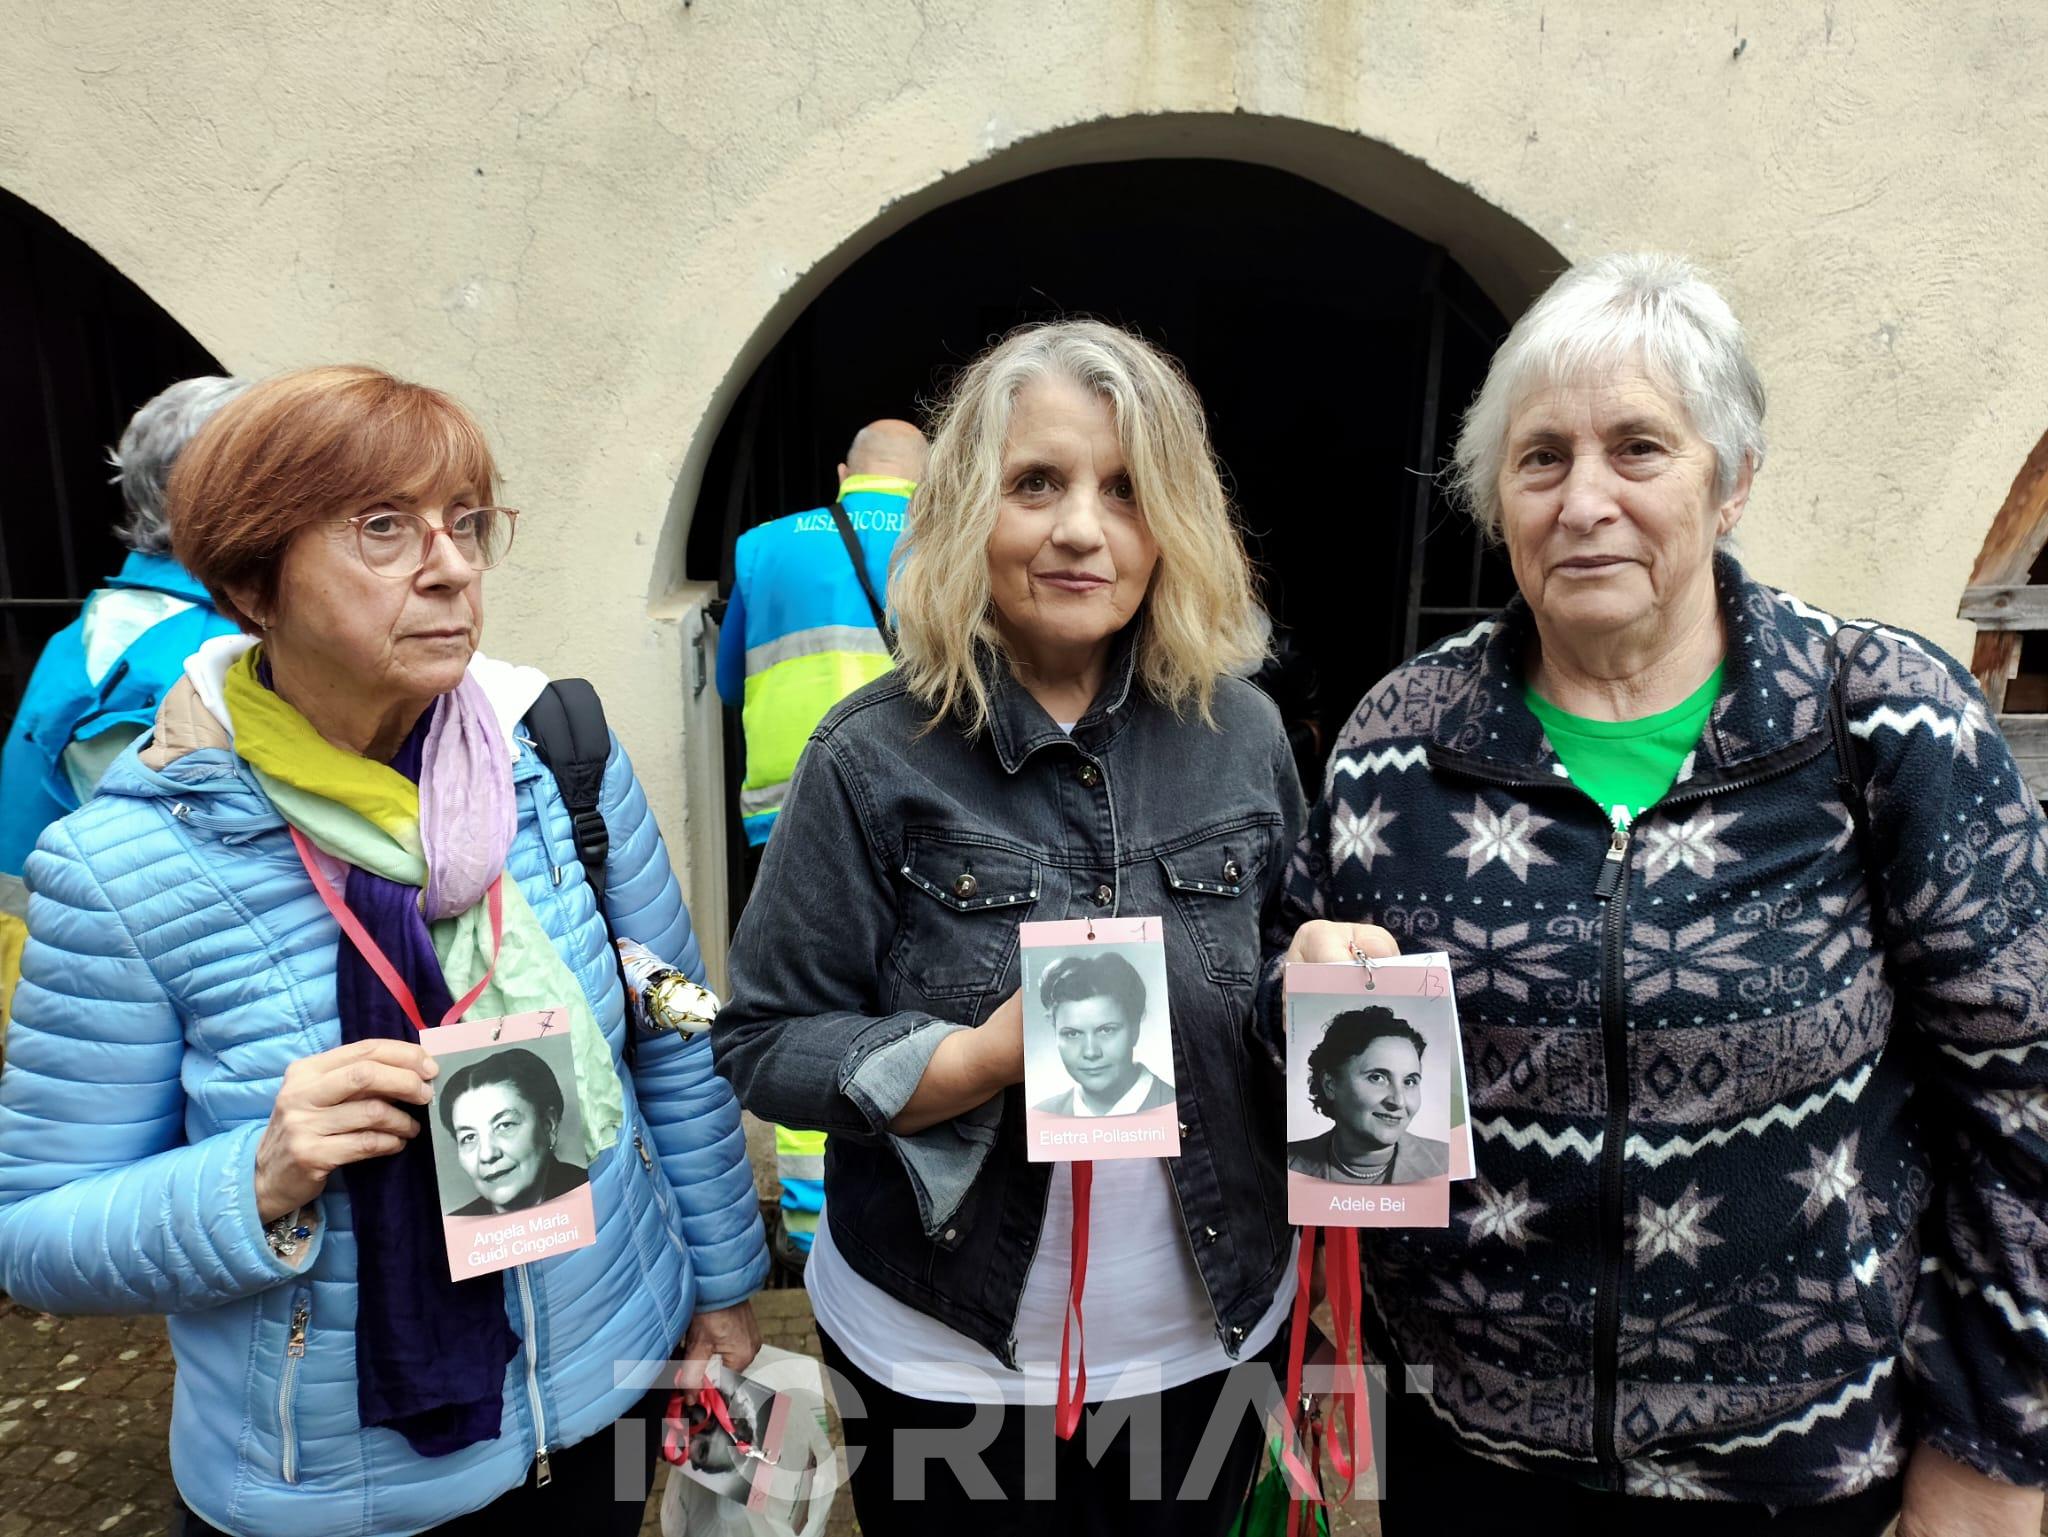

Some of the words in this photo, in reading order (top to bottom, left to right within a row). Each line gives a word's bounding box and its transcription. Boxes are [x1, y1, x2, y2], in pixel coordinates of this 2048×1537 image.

[1417, 968, 1445, 1002] 13
[537, 1010, 555, 1039] 7
[1039, 1129, 1089, 1146] Elettra
[1092, 1126, 1166, 1144] Pollastrini
[1328, 1195, 1376, 1212] Adele
[1380, 1197, 1406, 1212] Bei
[473, 1223, 526, 1248] Angela
[528, 1212, 570, 1233] Maria
[467, 1245, 509, 1267] Guidi
[511, 1226, 580, 1256] Cingolani
